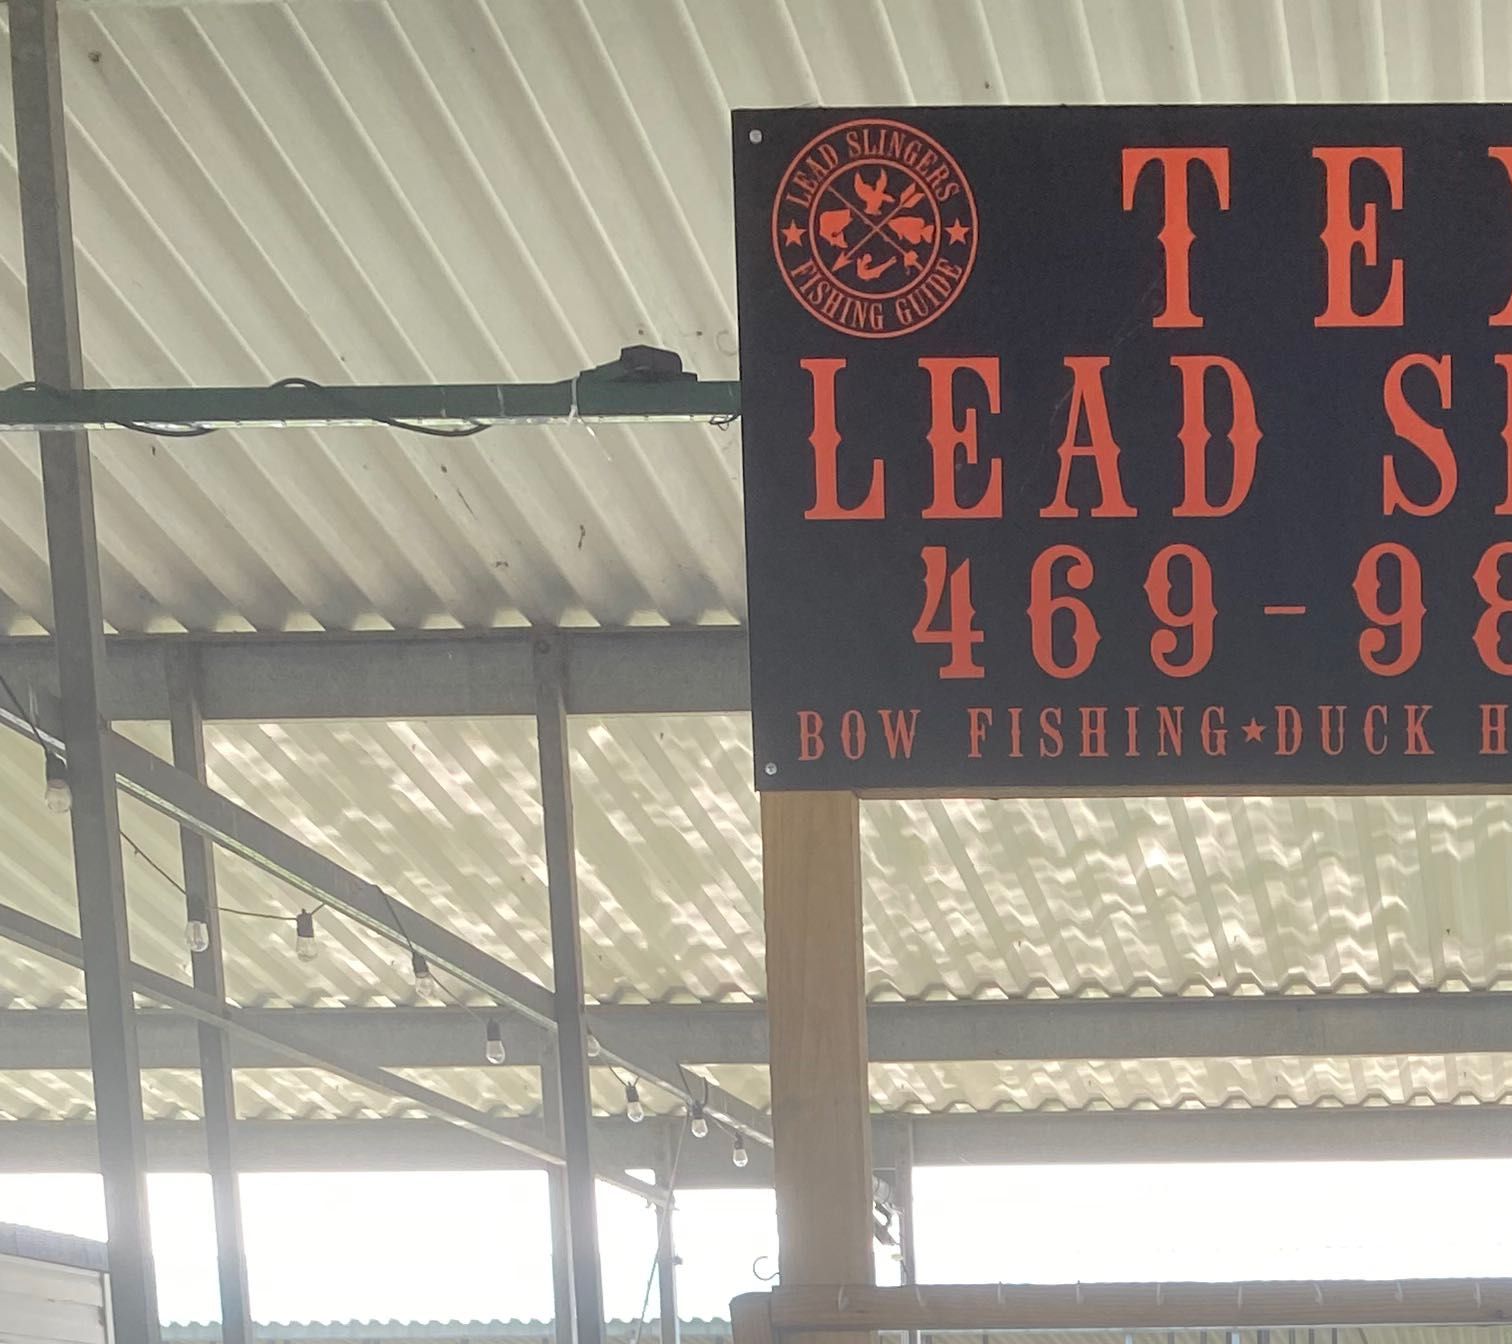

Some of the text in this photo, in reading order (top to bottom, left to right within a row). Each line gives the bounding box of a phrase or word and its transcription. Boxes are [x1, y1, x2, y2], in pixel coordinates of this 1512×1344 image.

[786, 128, 961, 208] LEAD SLINGERS
[790, 257, 963, 330] FISHING GUIDE
[799, 354, 1264, 521] LEAD
[798, 707, 920, 761] BOW
[967, 706, 1228, 759] FISHING
[1275, 705, 1434, 757] DUCK
